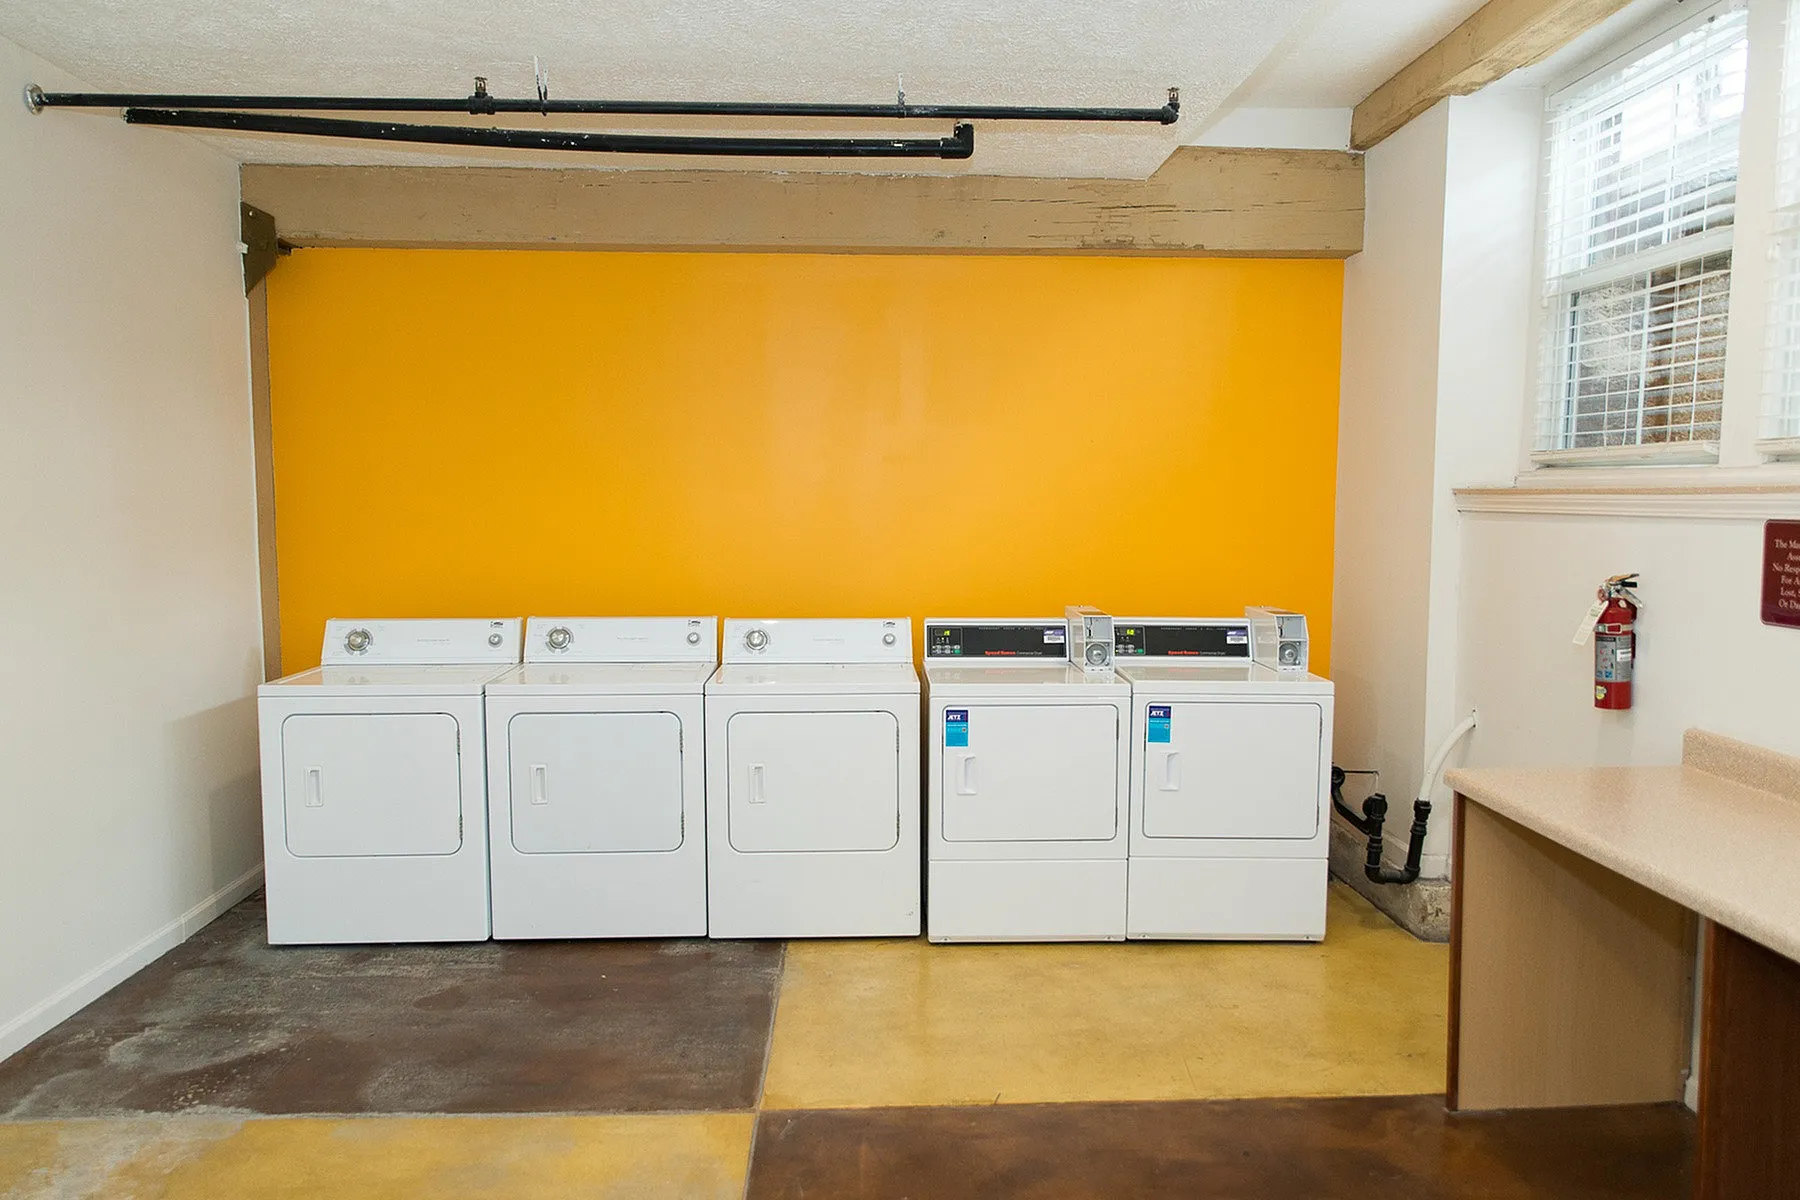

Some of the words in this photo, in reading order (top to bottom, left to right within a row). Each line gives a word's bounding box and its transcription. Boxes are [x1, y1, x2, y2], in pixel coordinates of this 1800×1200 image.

[1774, 539, 1787, 548] The
[1772, 562, 1783, 571] No
[1780, 575, 1791, 583] For
[1778, 599, 1788, 608] Or
